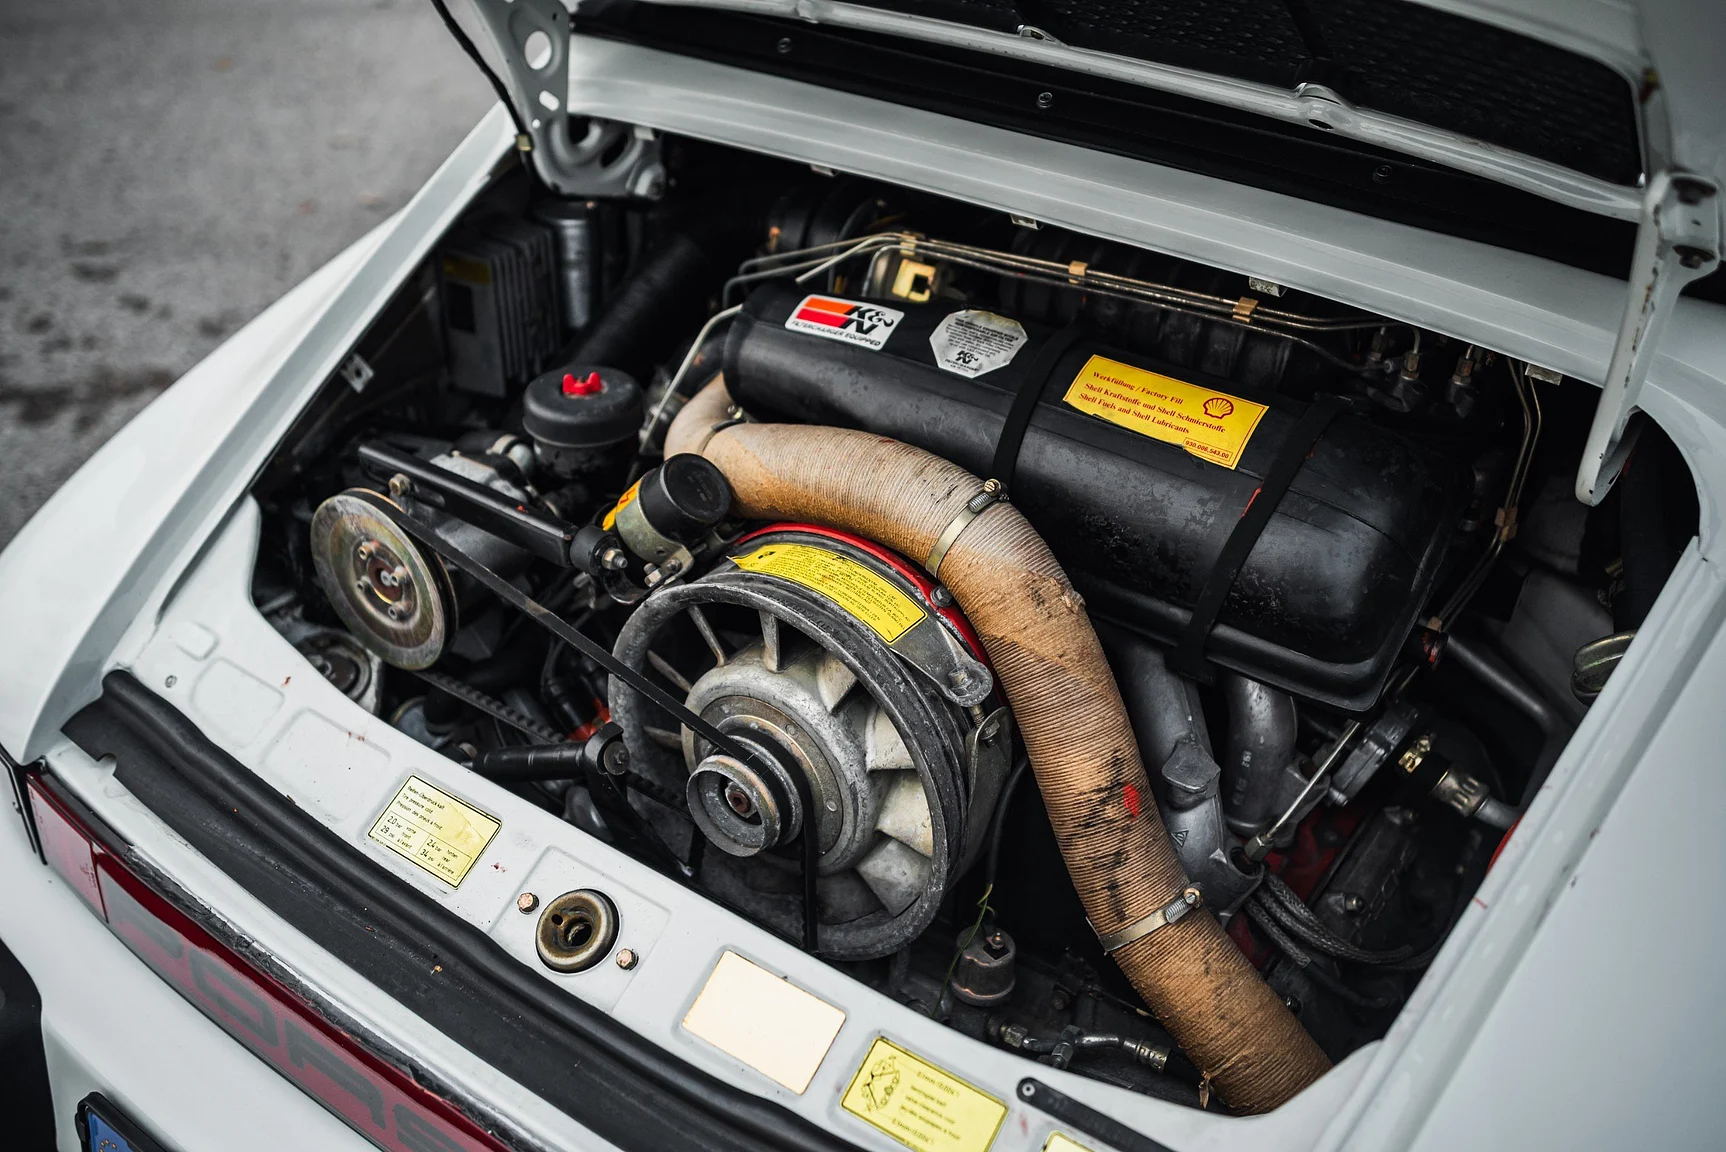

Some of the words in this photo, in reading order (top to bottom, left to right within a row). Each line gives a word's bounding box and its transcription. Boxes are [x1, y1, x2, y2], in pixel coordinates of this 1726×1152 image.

[840, 306, 894, 335] K&N
[845, 333, 881, 346] EQUIPPED
[1093, 372, 1135, 391] Werkfüllung
[1141, 387, 1168, 400] Factory
[1170, 397, 1184, 405] Fill
[1079, 393, 1097, 403] Shell
[1098, 399, 1116, 410] Fuels
[1118, 406, 1131, 414] and
[1132, 410, 1151, 421] Shell
[1152, 417, 1190, 434] Lubricants
[1085, 383, 1103, 393] Shell
[1104, 389, 1141, 406] Kraftstoffe
[1143, 402, 1156, 410] und
[1157, 407, 1176, 417] Shell
[1176, 412, 1225, 433] Schmierstoffe
[420, 849, 429, 857] 34
